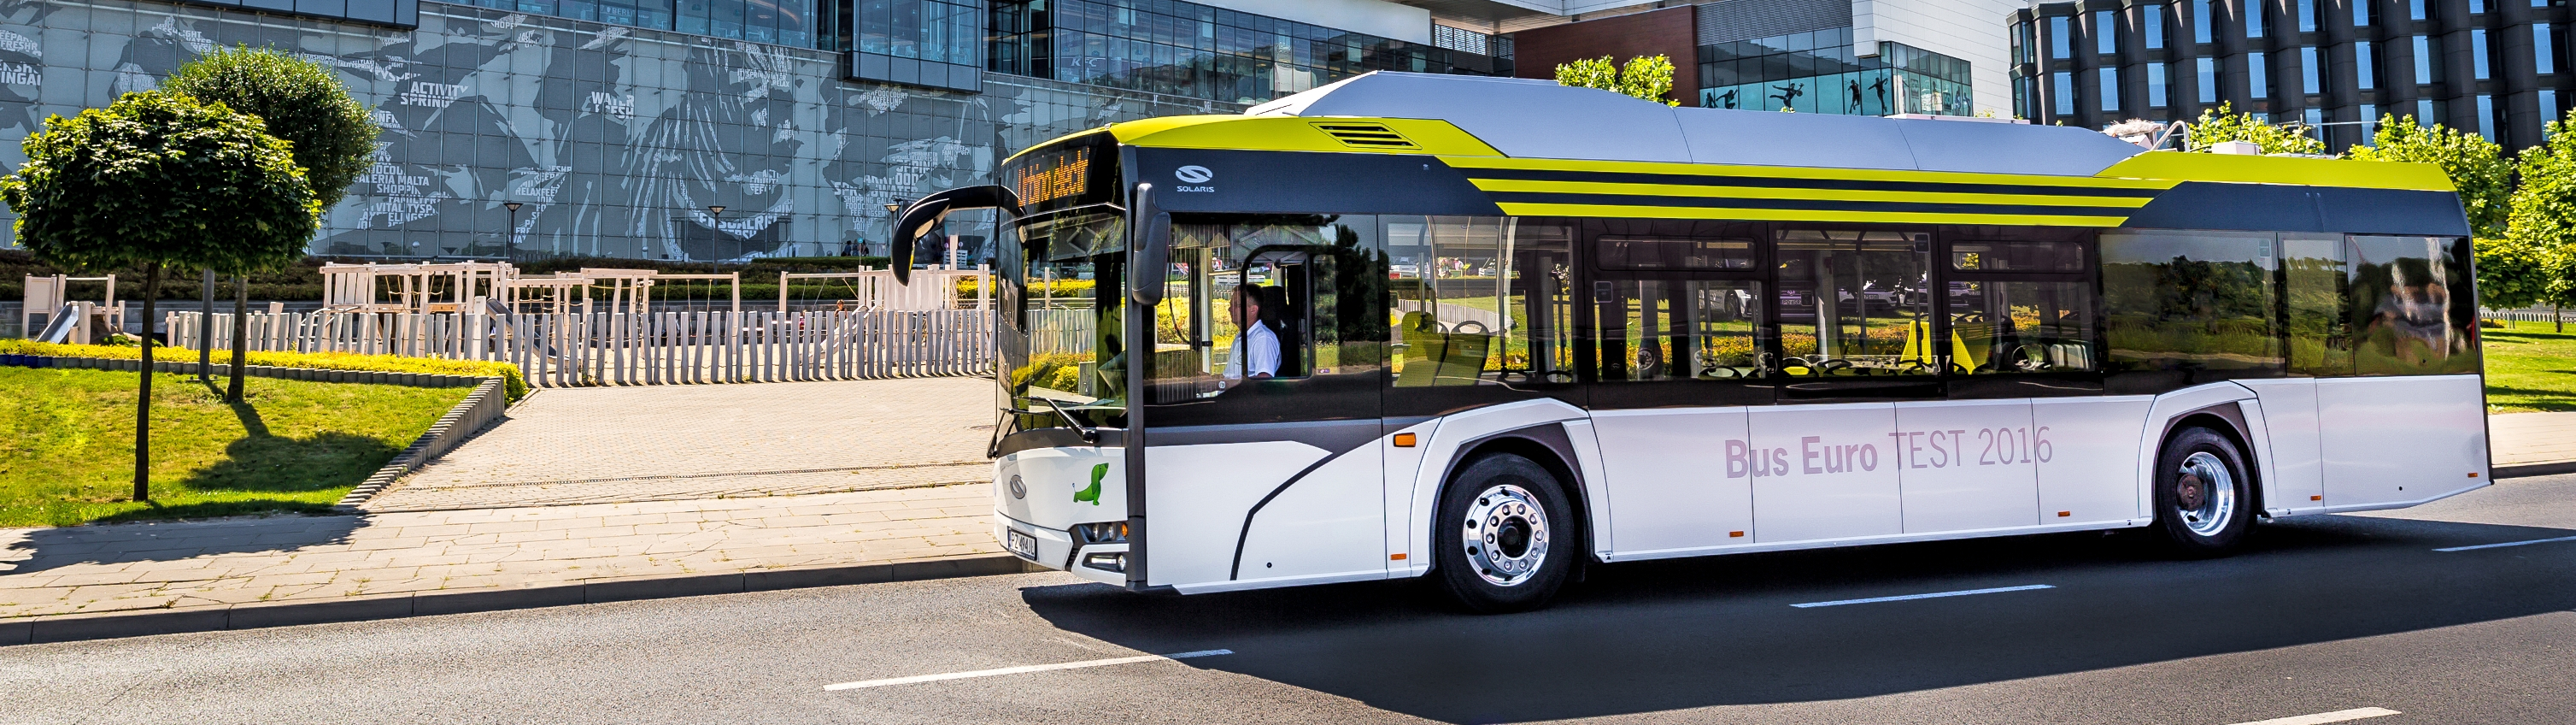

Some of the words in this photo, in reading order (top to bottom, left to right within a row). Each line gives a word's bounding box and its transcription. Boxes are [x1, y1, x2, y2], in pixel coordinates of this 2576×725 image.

[354, 174, 395, 184] ALERIA
[398, 176, 430, 186] MALTA
[377, 184, 423, 197] SHOPPIN
[1018, 163, 1052, 207] Urbino
[1724, 439, 1790, 479] Bus
[1800, 435, 1879, 475] Euro
[1887, 429, 1965, 470] TEST
[1977, 425, 2053, 466] 2016
